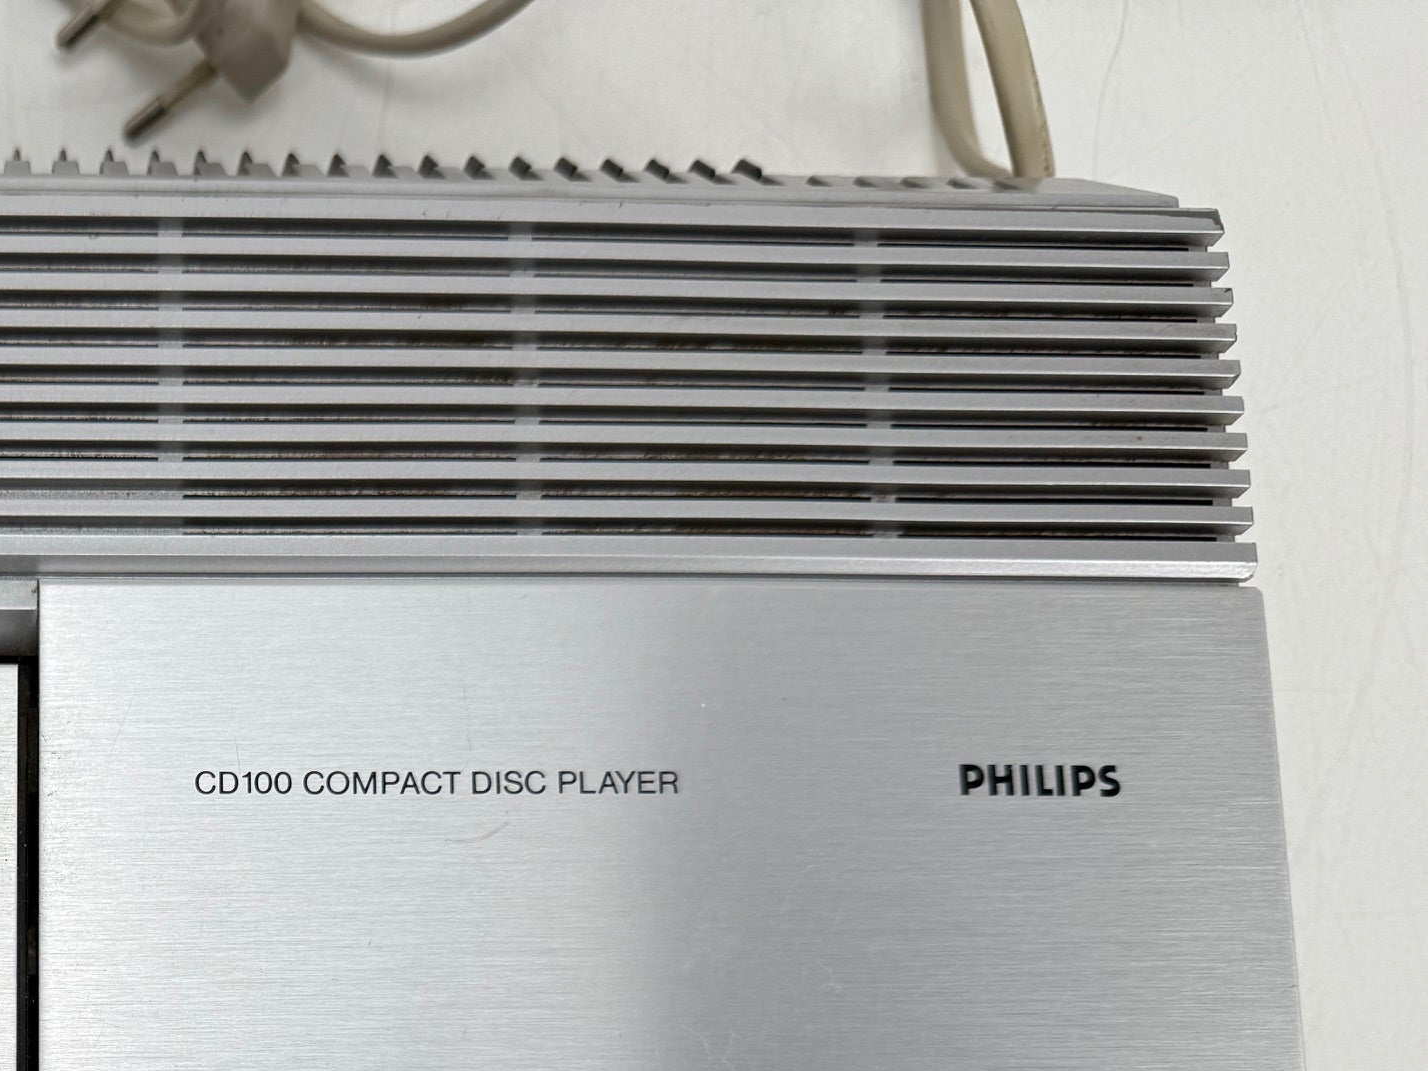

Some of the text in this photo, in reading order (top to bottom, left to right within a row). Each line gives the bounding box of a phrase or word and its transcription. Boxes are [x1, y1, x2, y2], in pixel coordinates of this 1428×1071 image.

[194, 770, 680, 795] CD100 COMPACT DISC PLAYER
[958, 764, 1121, 797] PHILIPS
